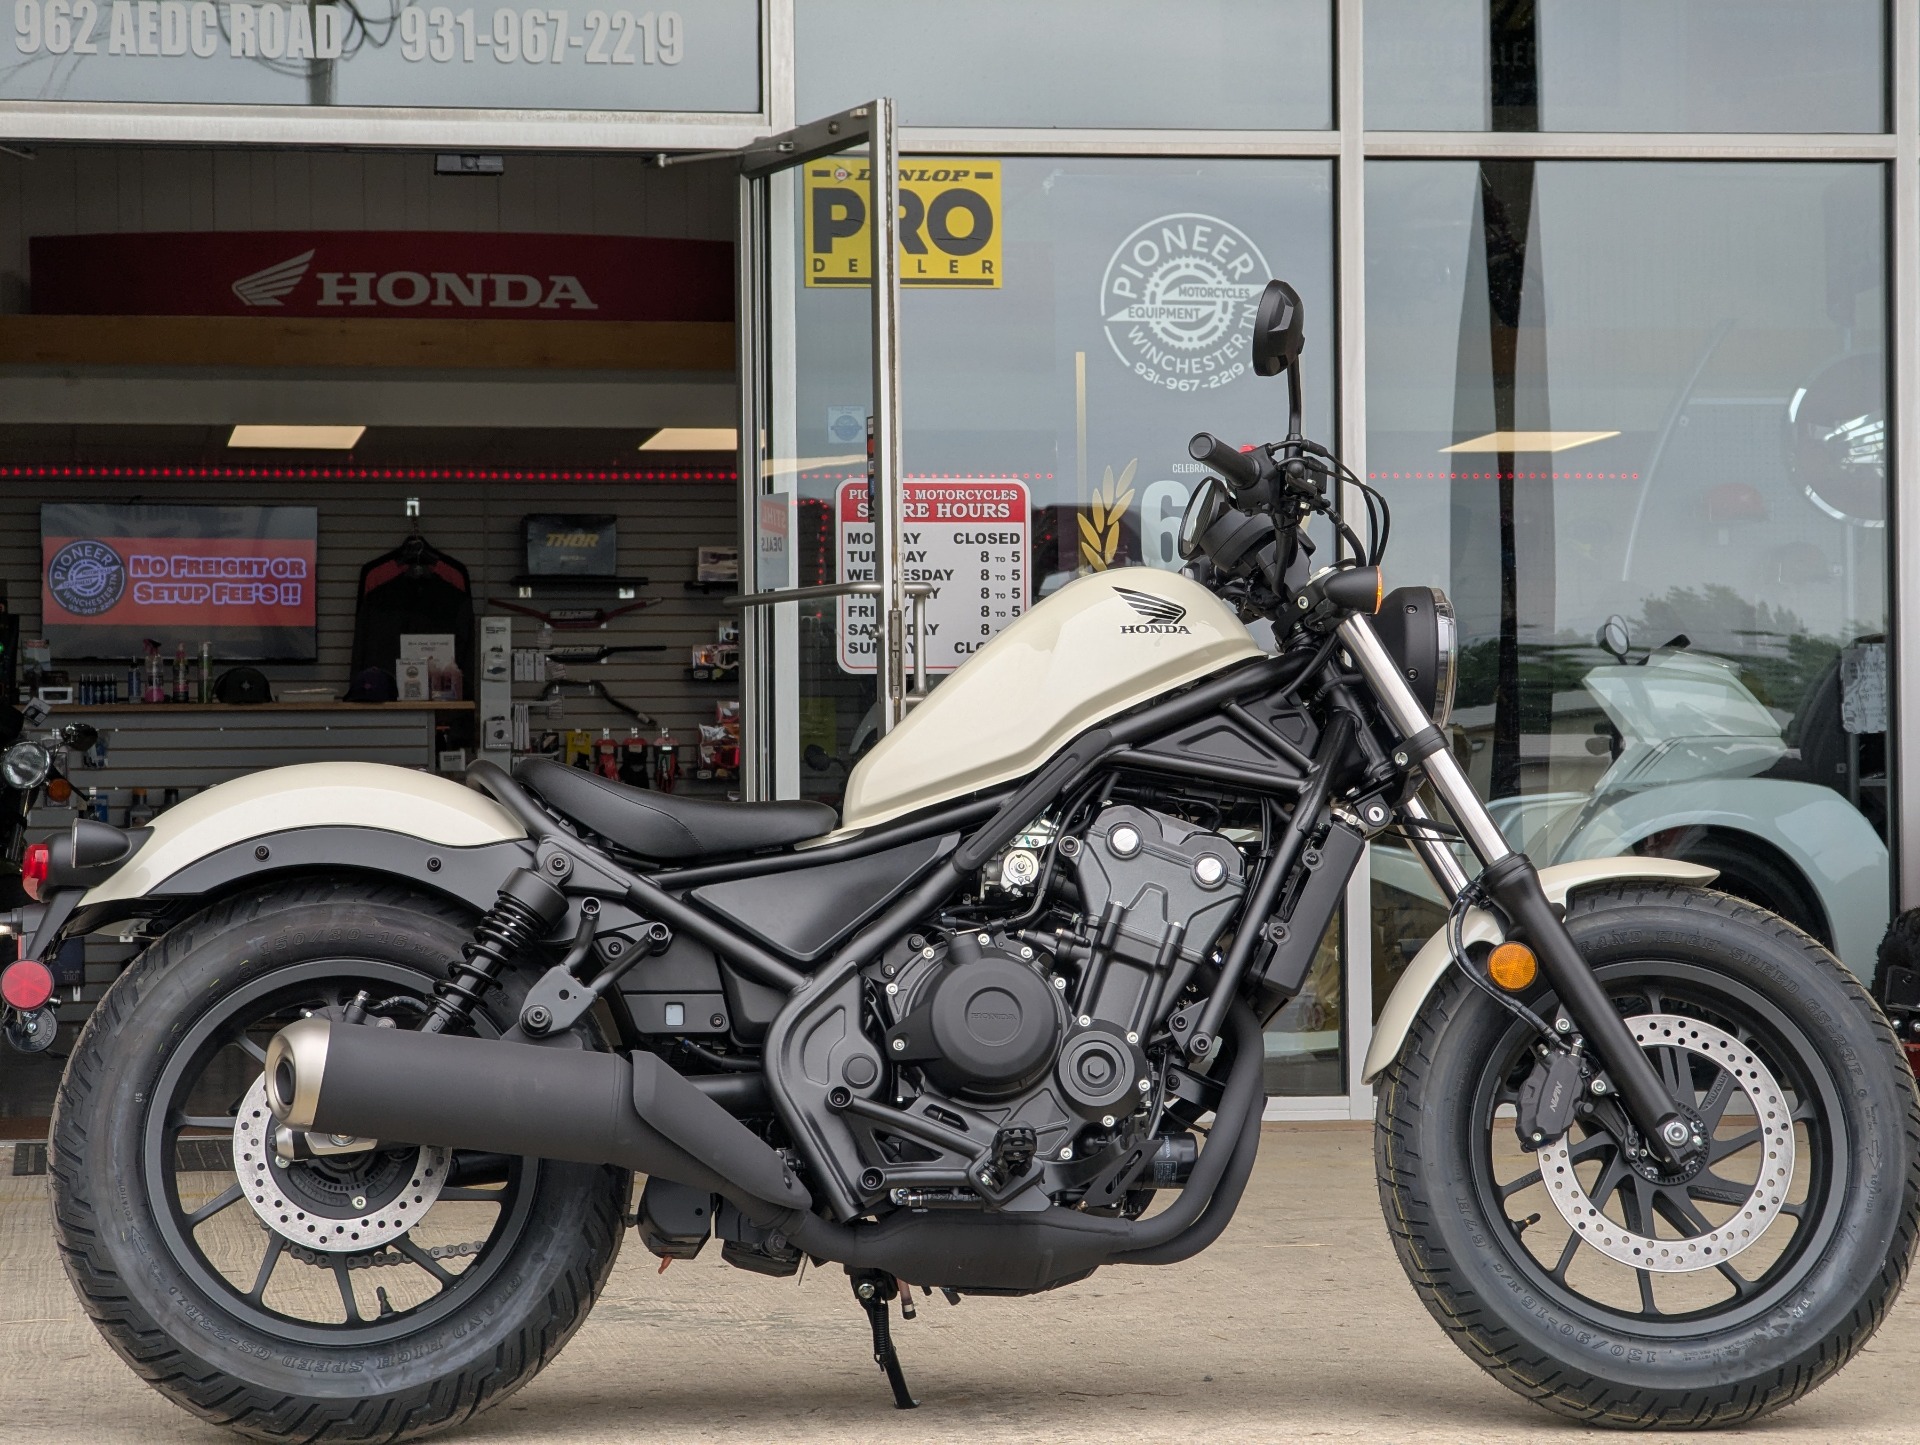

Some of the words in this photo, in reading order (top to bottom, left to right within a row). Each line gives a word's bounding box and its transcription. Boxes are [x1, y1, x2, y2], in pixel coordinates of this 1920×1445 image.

[14, 0, 98, 56] 962
[108, 1, 219, 58] AEDC
[230, 5, 342, 60] ROAD
[400, 10, 685, 65] 931-967-2219
[855, 169, 970, 182] DNLOP
[813, 258, 994, 275] DELER
[1112, 224, 1254, 299] PIONEER
[317, 272, 599, 310] HONDA
[1178, 286, 1251, 299] MOTORCYCLES
[1128, 306, 1201, 320] EQUIPMENT
[1134, 362, 1245, 391] 931-967-2219
[915, 489, 1018, 501] MOTORCYCLES
[857, 502, 930, 518] SRE
[936, 503, 1011, 518] HOURS
[545, 533, 600, 547] THOR
[847, 533, 922, 545] MOAY
[953, 532, 1021, 545] CLOSED
[54, 545, 113, 580] PIONEER
[980, 551, 990, 563] 8
[1011, 551, 1021, 563] 5
[980, 569, 990, 581] 8
[1011, 569, 1021, 581] 5
[980, 587, 990, 599] 8
[1011, 587, 1021, 599] 5
[981, 606, 990, 618] 8
[1011, 606, 1021, 618] 5
[981, 624, 990, 636] 8
[1120, 624, 1192, 635] HONDA
[1654, 929, 1721, 953] HIGH
[1728, 944, 1801, 994] SPEED
[376, 1337, 444, 1370] HIGH
[280, 1354, 365, 1375] SPEED
